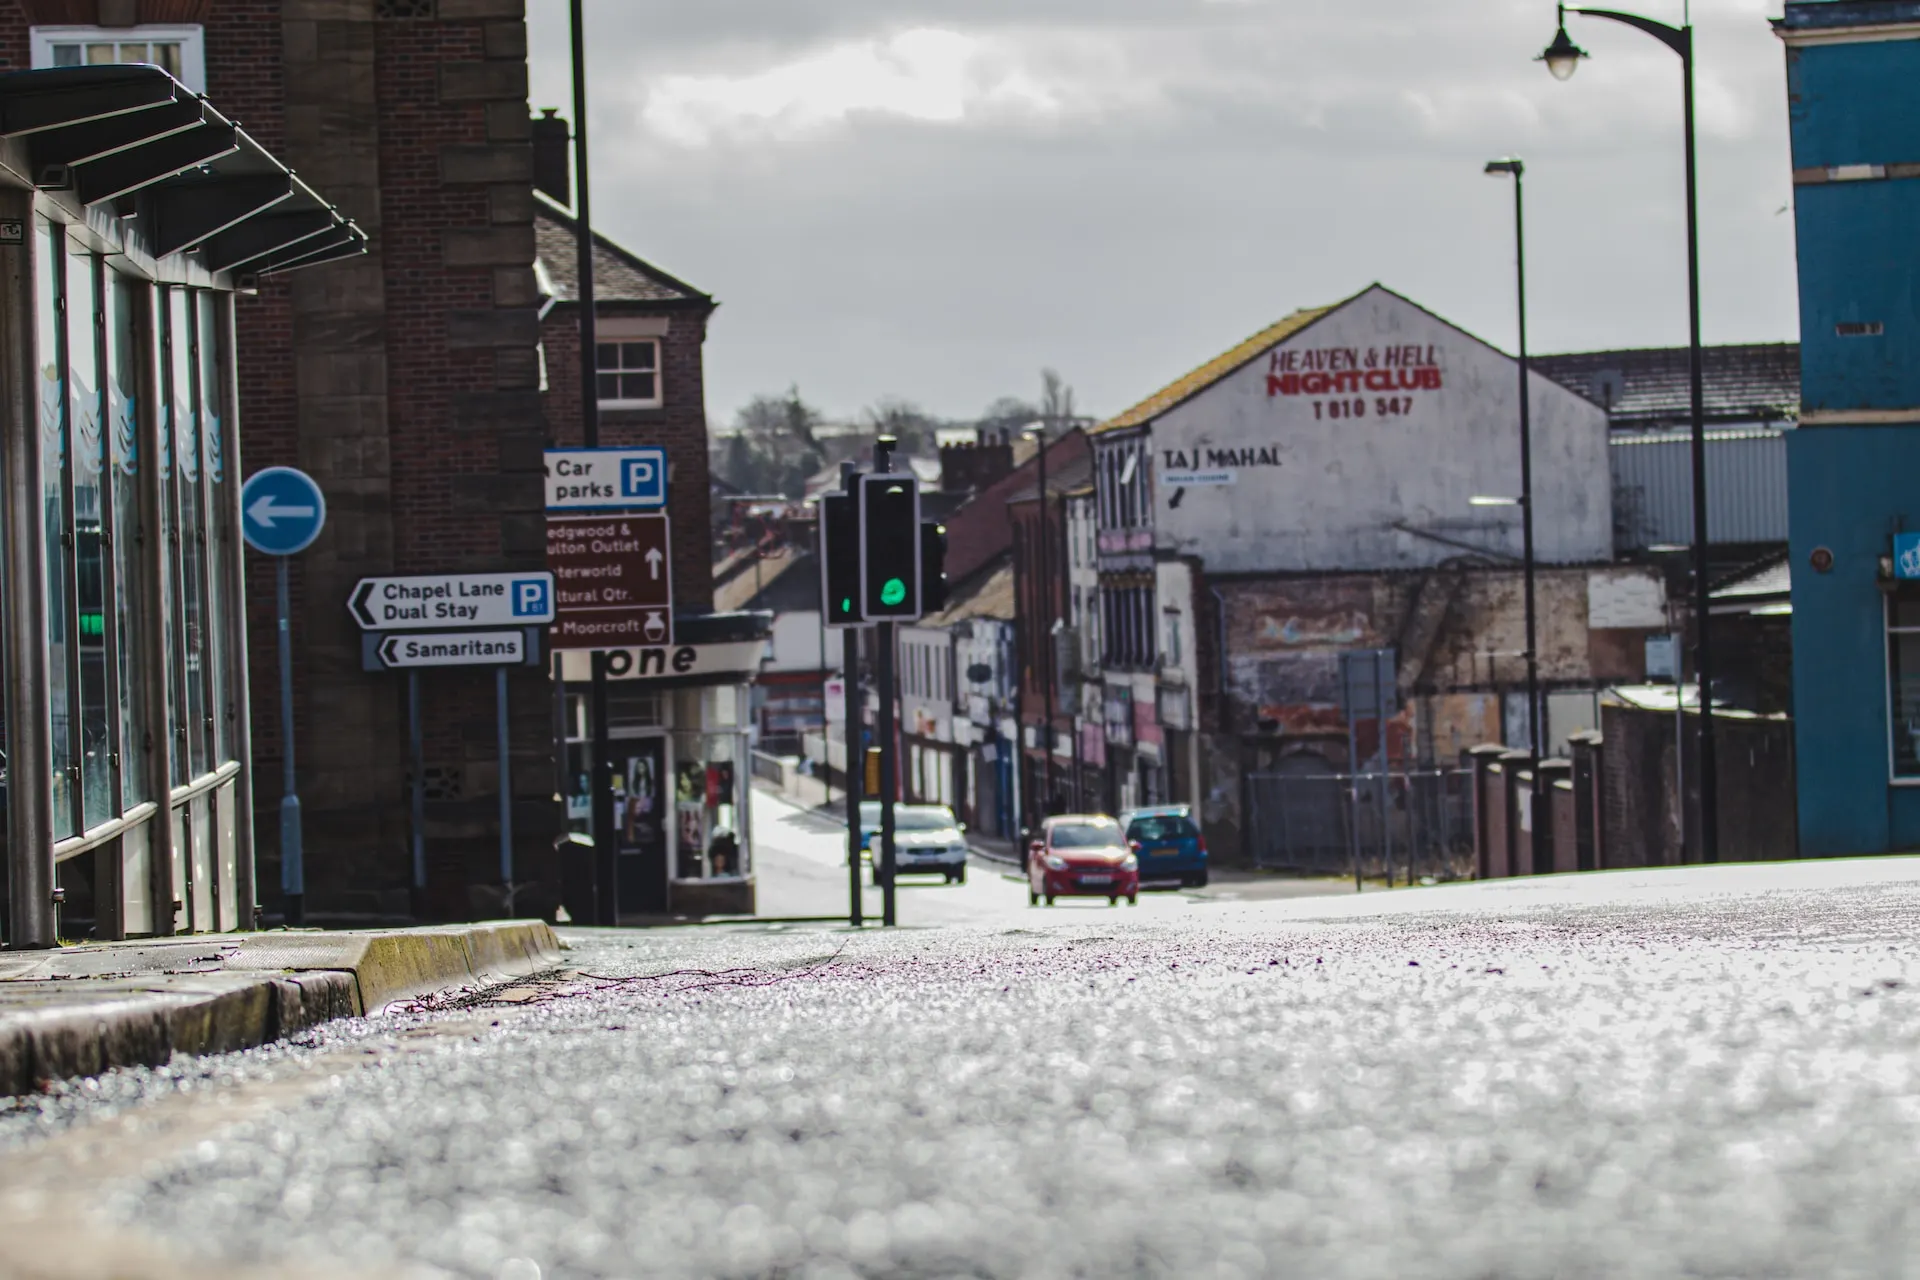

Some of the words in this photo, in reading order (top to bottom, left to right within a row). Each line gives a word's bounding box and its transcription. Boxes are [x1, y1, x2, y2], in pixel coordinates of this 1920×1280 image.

[1270, 347, 1358, 371] HEAVEN
[1364, 347, 1379, 367] &
[1384, 344, 1437, 366] HELL
[1266, 367, 1442, 397] NIGHTCLUB
[1376, 396, 1413, 417] 547
[1163, 448, 1199, 471] TAJ
[1206, 446, 1282, 468] MAHAL
[556, 460, 592, 477] Car
[629, 462, 653, 493] P
[556, 482, 614, 501] parks
[547, 524, 615, 540] edgwood
[620, 523, 631, 536] &
[547, 541, 586, 555] ulton
[591, 539, 640, 554] Outlet
[556, 563, 622, 579] terworld
[383, 582, 452, 601] Chapel
[459, 582, 505, 597] Lane
[556, 590, 598, 603] ltural
[602, 587, 633, 602] Qtr.
[383, 603, 428, 620] Dual
[435, 602, 479, 620] Stay
[562, 619, 640, 635] Moorcroft
[405, 640, 517, 658] Samaritans
